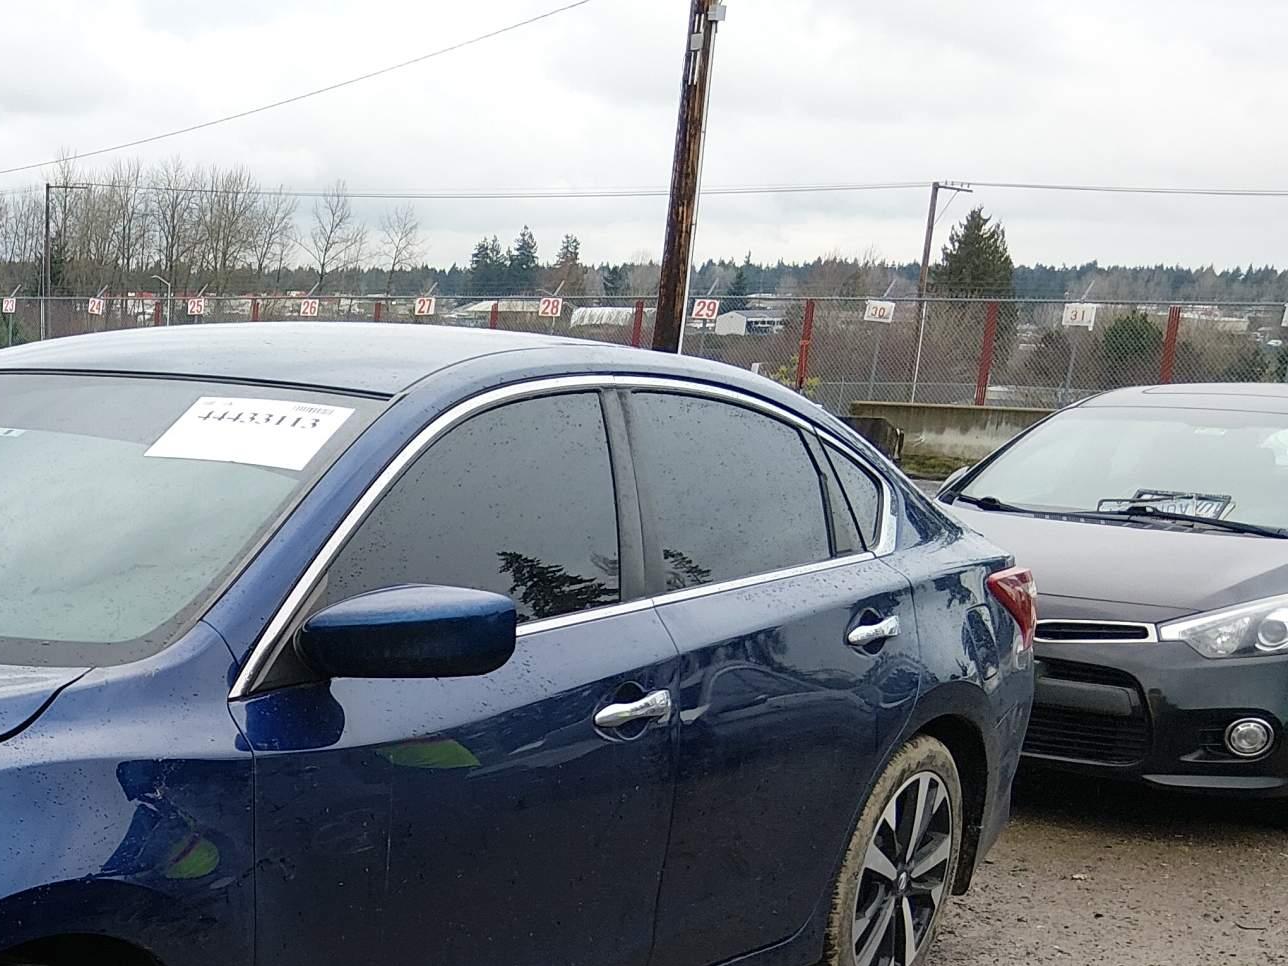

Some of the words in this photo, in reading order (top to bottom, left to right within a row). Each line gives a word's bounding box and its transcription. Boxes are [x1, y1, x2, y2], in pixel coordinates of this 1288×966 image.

[3, 299, 15, 312] 23
[89, 299, 102, 314] 24
[188, 299, 203, 315] 25
[301, 300, 317, 315] 26
[417, 298, 433, 314] 27
[540, 298, 560, 316] 28
[694, 300, 717, 318] 29
[870, 306, 886, 318] 30
[1070, 310, 1086, 321] 31
